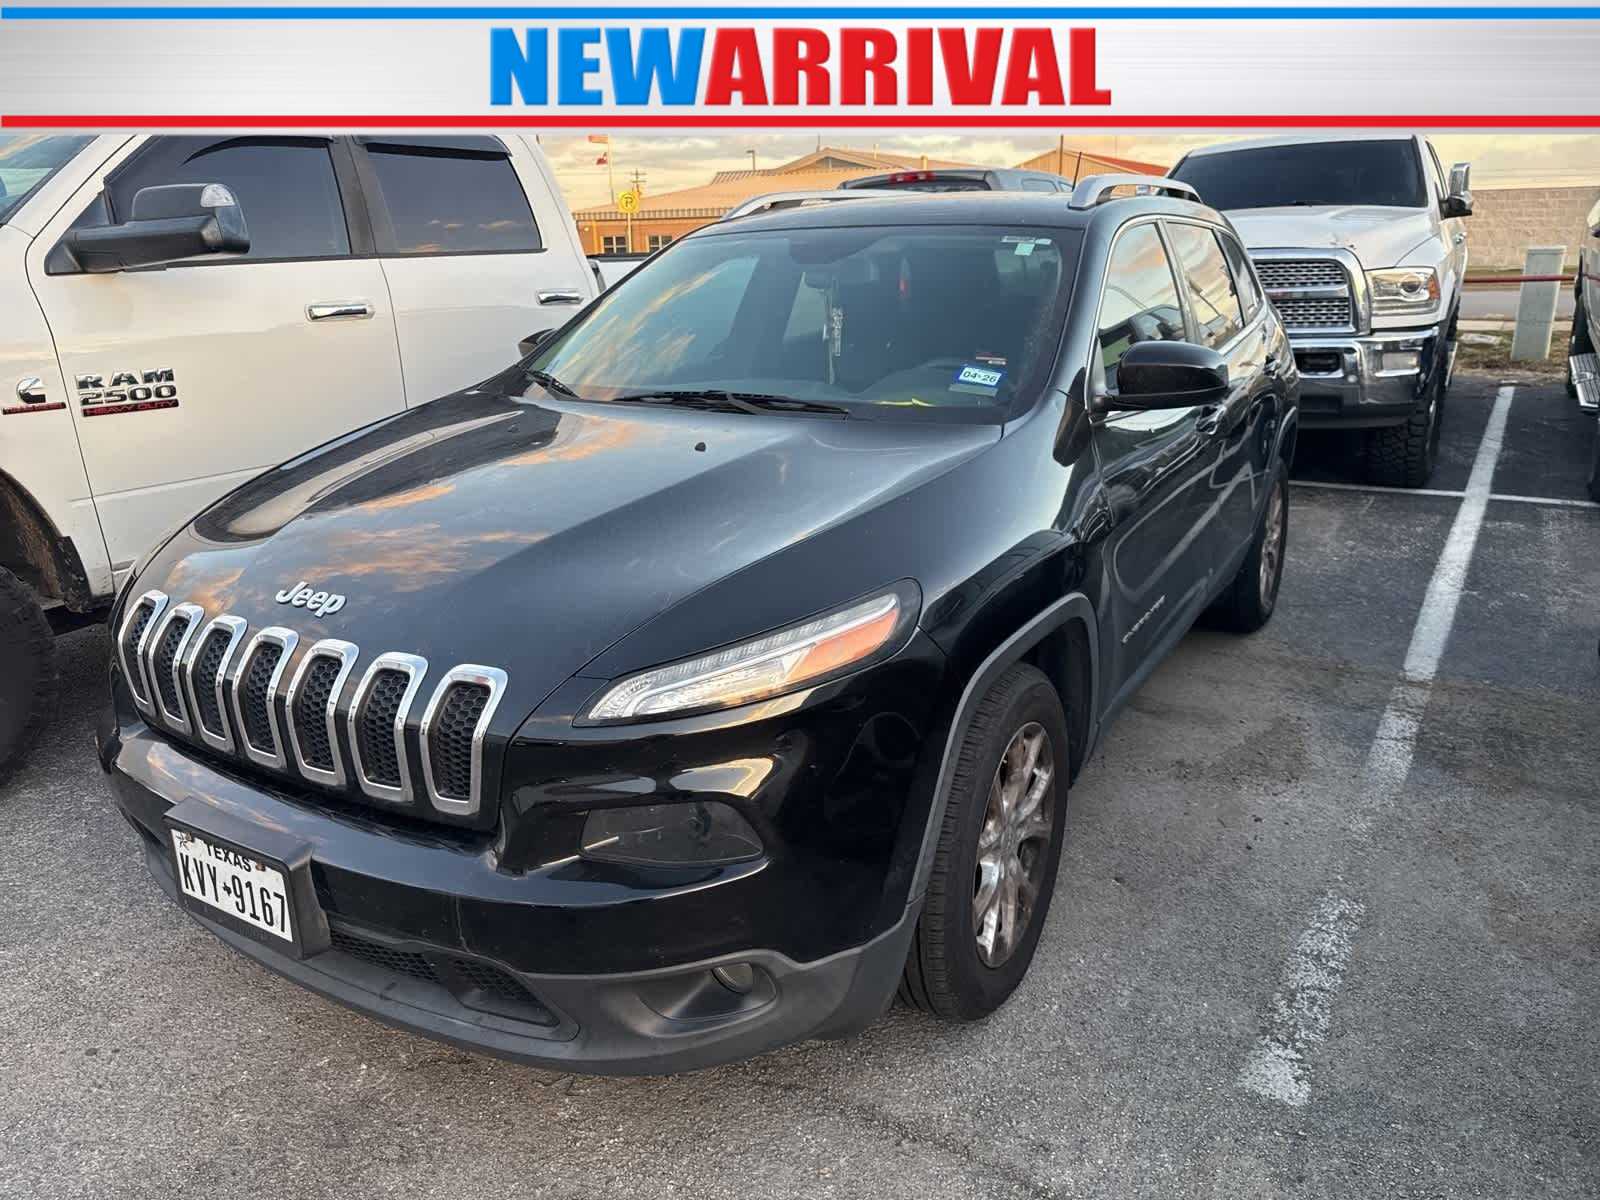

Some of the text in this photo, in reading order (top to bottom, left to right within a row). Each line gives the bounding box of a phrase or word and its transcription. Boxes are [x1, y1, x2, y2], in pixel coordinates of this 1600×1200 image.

[76, 368, 174, 389] RAM
[78, 384, 177, 406] 2500
[275, 581, 346, 617] Jeep
[205, 842, 252, 872] TEXAS
